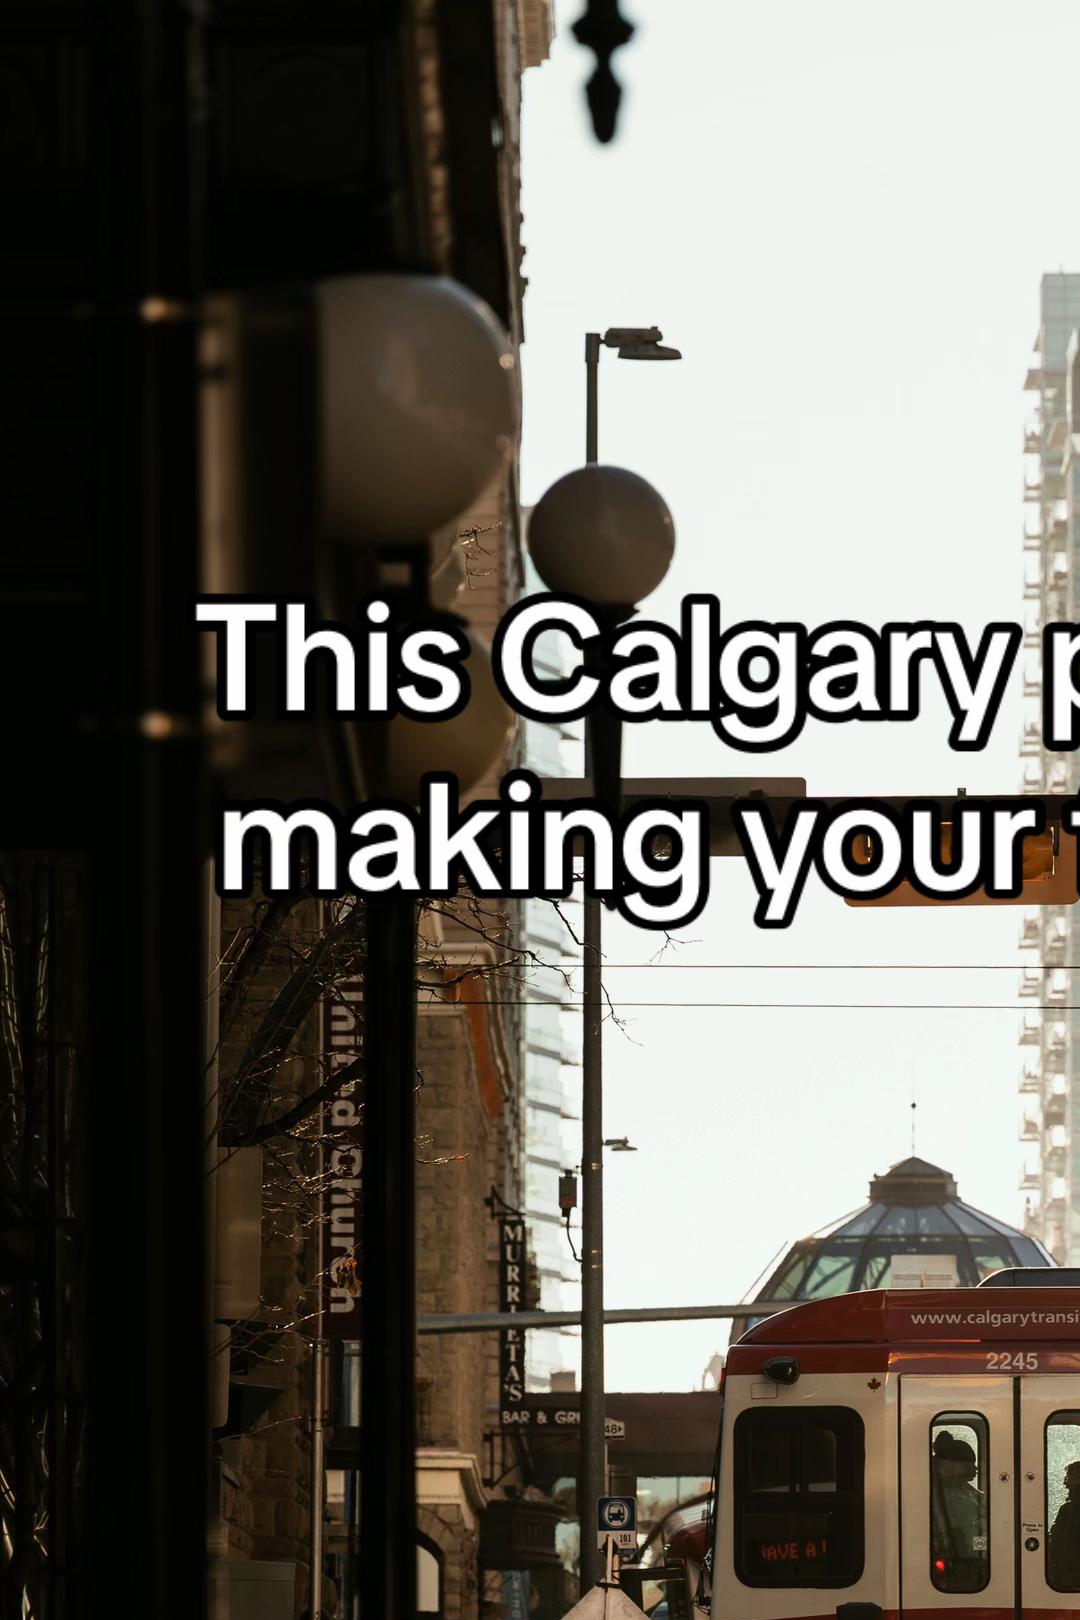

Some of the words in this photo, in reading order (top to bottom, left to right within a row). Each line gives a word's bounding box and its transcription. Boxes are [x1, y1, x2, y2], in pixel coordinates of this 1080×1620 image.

[985, 1352, 1039, 1370] 2245
[502, 1411, 530, 1425] BAR
[536, 1411, 548, 1425] &
[555, 1410, 581, 1425] GRI
[620, 1534, 632, 1543] 101
